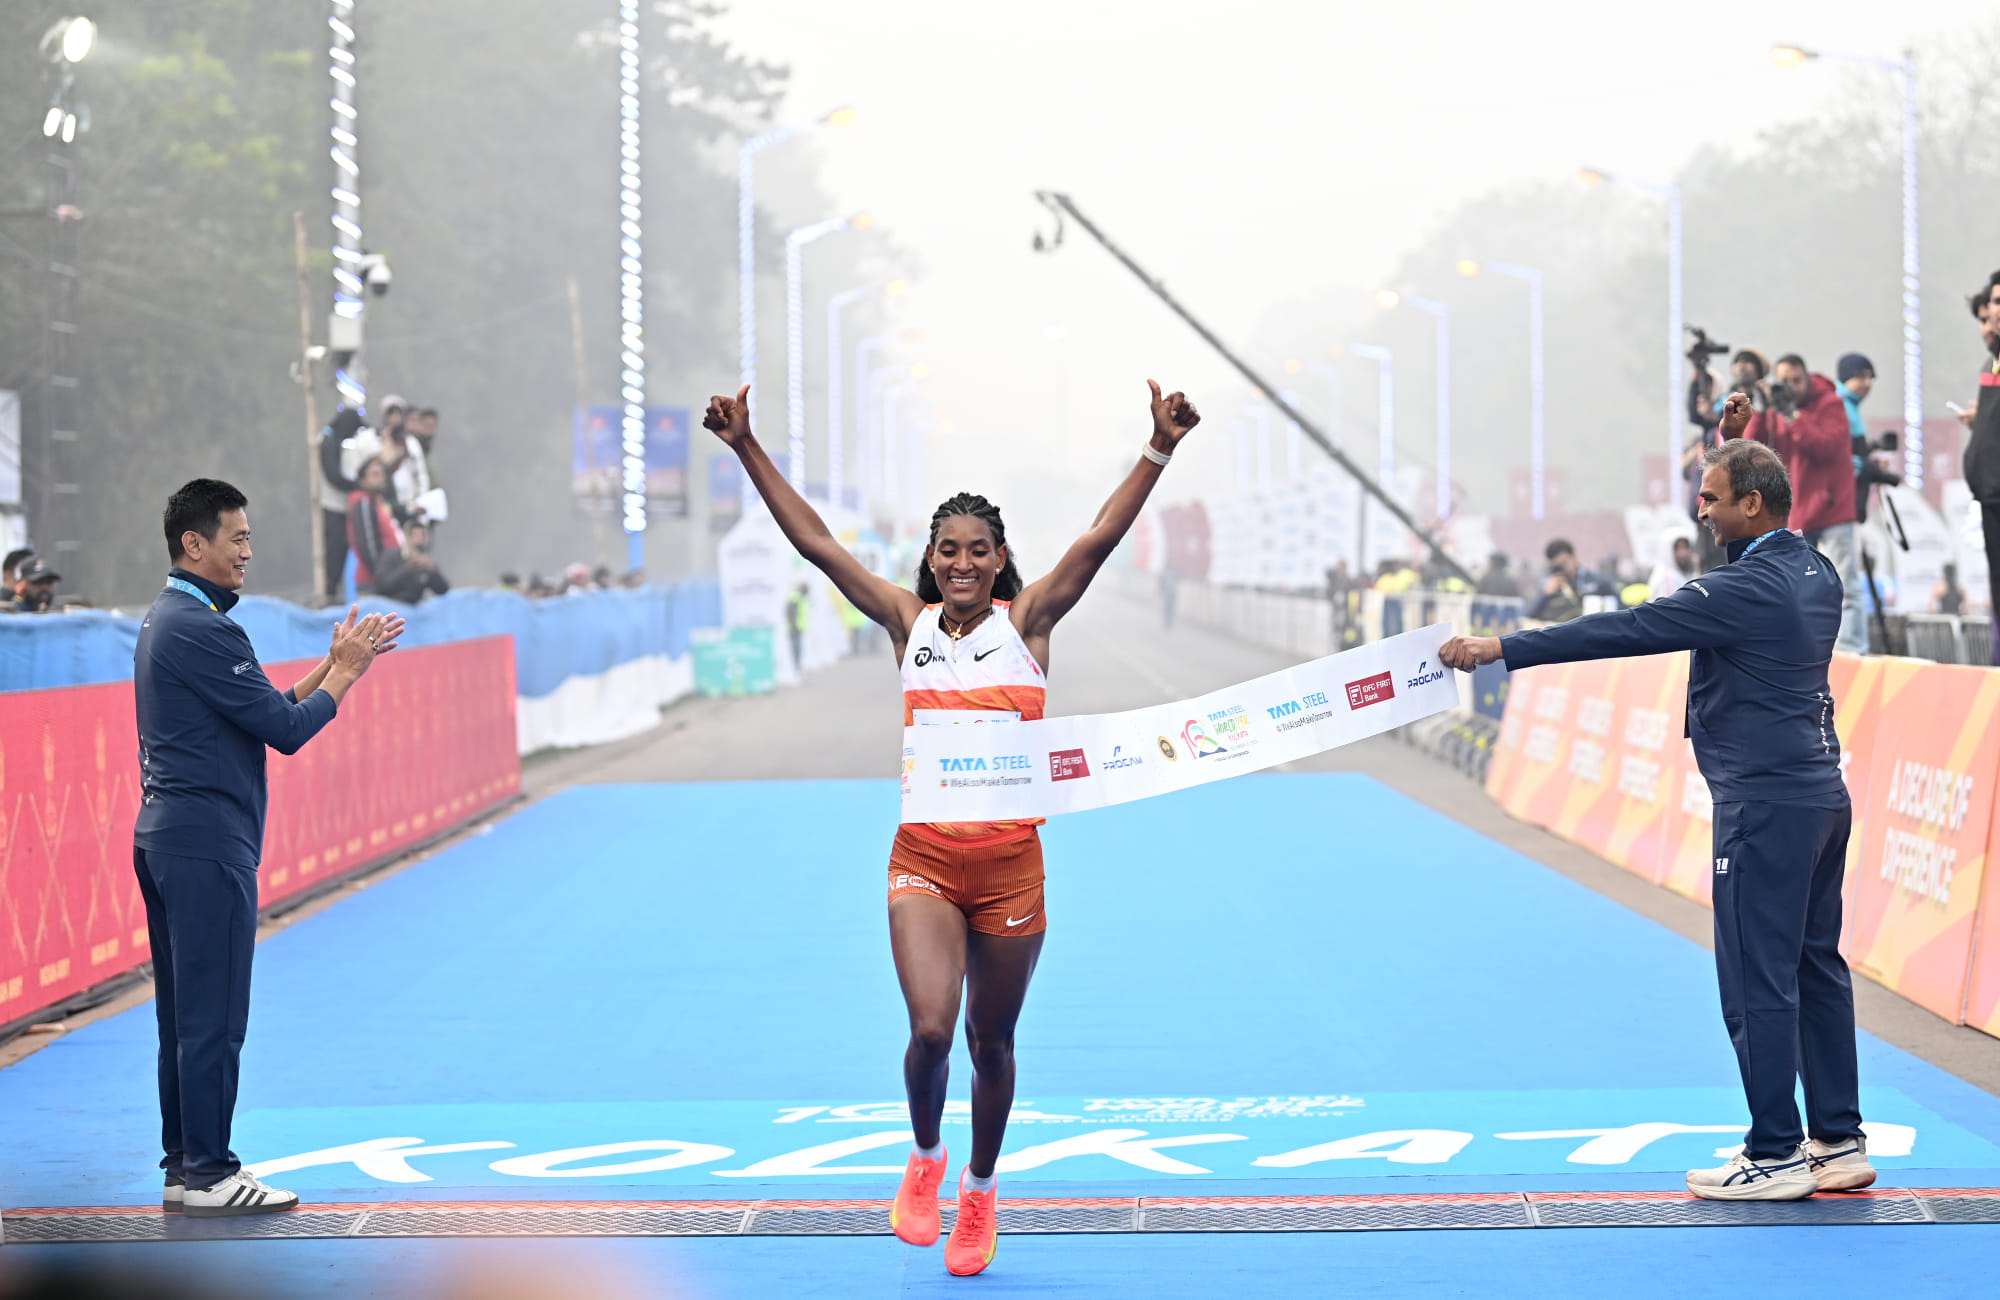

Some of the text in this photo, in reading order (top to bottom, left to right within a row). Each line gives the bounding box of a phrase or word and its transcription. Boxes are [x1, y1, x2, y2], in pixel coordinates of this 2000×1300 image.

[1376, 678, 1391, 689] FIRST
[1407, 670, 1444, 688] PROCAM
[1266, 691, 1329, 720] TATA STEEL
[1364, 693, 1379, 702] Bank
[1207, 705, 1245, 722] TATA STEEL
[939, 755, 1032, 772] TATA STEEL
[1102, 756, 1143, 770] PROCAM
[1886, 759, 1973, 831] A DECADE OF
